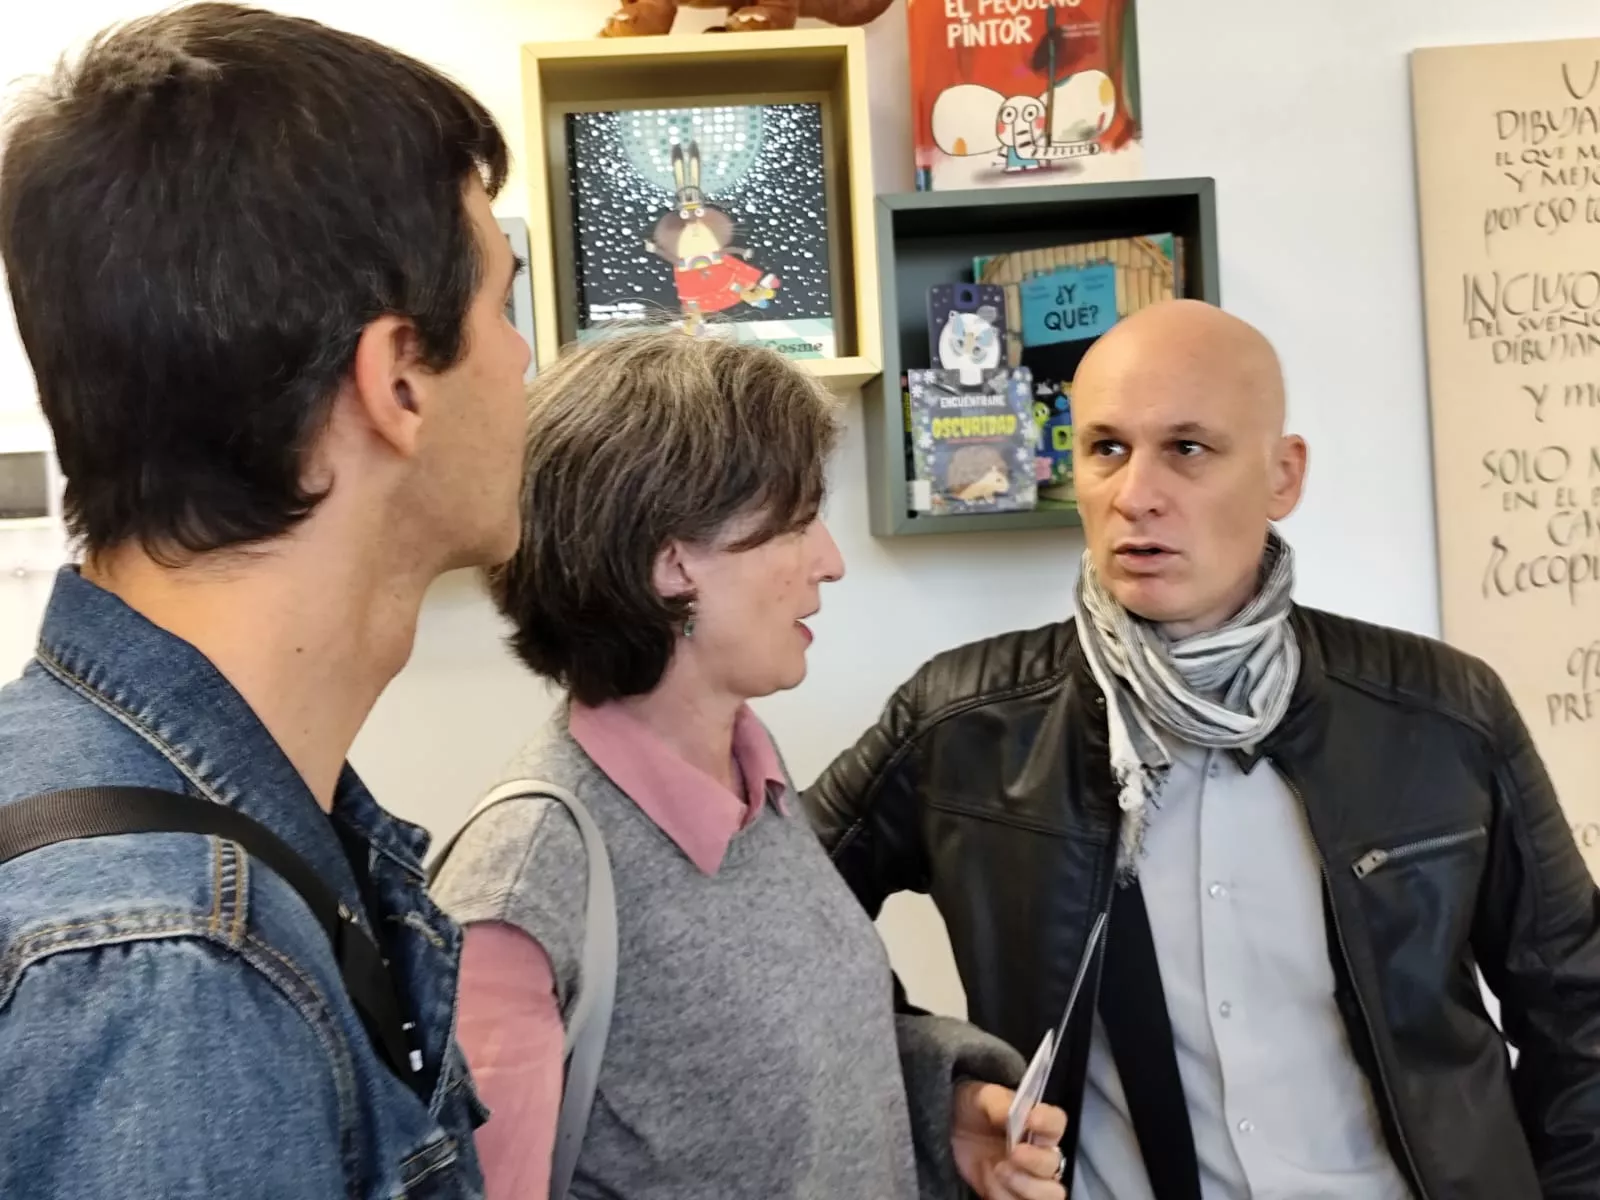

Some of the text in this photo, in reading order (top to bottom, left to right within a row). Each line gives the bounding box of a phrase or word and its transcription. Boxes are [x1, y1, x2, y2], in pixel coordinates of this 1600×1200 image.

[1495, 151, 1515, 167] EL
[1521, 146, 1565, 168] QUE
[1055, 283, 1077, 306] ¿Y
[1468, 317, 1504, 340] DEL
[932, 414, 1017, 440] OSCURIDAD
[1480, 445, 1571, 489] SOLO
[1502, 490, 1539, 511] EN
[1555, 486, 1577, 508] EL
[1547, 509, 1600, 547] CA
[1546, 689, 1600, 727] PRE
